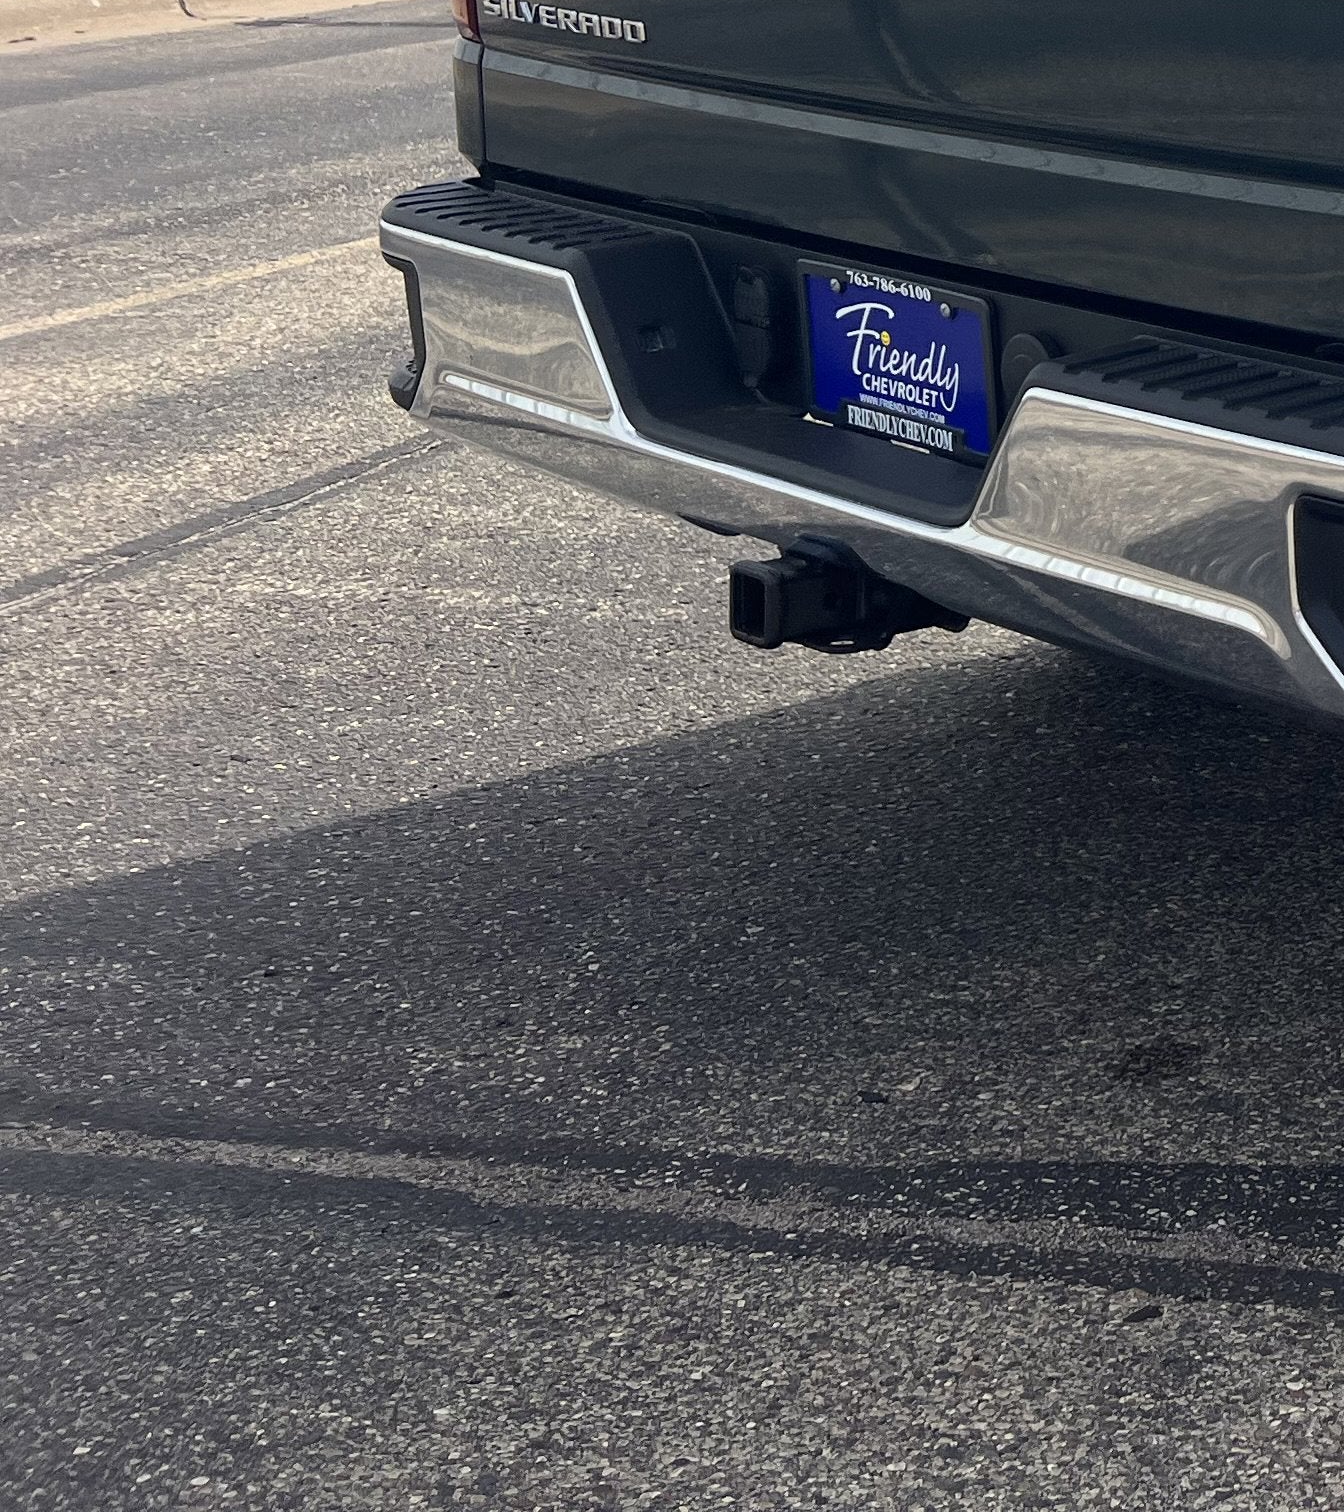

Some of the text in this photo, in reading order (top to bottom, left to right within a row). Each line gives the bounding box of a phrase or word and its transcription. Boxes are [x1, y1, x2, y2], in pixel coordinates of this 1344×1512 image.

[846, 270, 931, 303] 763-786-6100
[835, 302, 960, 412] Friendly
[862, 373, 938, 408] CHEVROLET
[847, 404, 954, 452] FRIENDLYCHEV.COM
